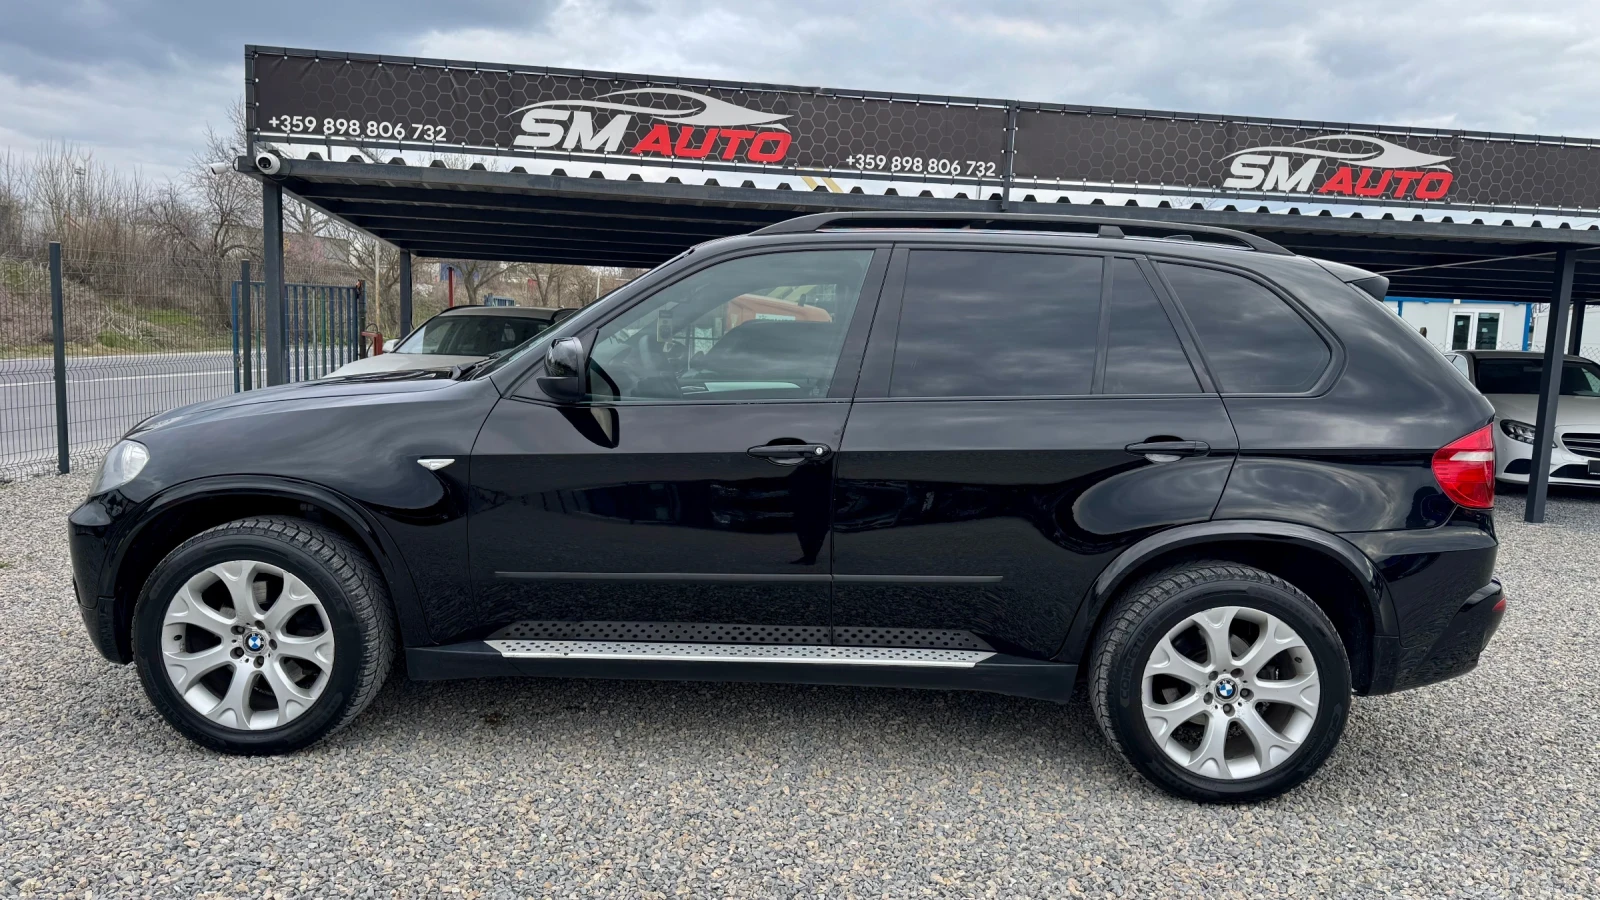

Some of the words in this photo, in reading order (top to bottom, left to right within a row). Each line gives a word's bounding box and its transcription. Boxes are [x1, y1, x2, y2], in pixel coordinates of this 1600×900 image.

[268, 115, 316, 132] +359
[323, 118, 360, 136] 898
[366, 121, 405, 139] 806
[411, 124, 447, 141] 732
[513, 108, 632, 152] SM
[630, 123, 792, 162] AUTO
[846, 154, 886, 169] +359
[891, 156, 923, 172] 898
[927, 158, 961, 174] 806
[966, 160, 996, 177] 732
[1222, 154, 1324, 192] SM
[1317, 166, 1454, 199] AUTO
[1121, 624, 1155, 699] COMPETUS
